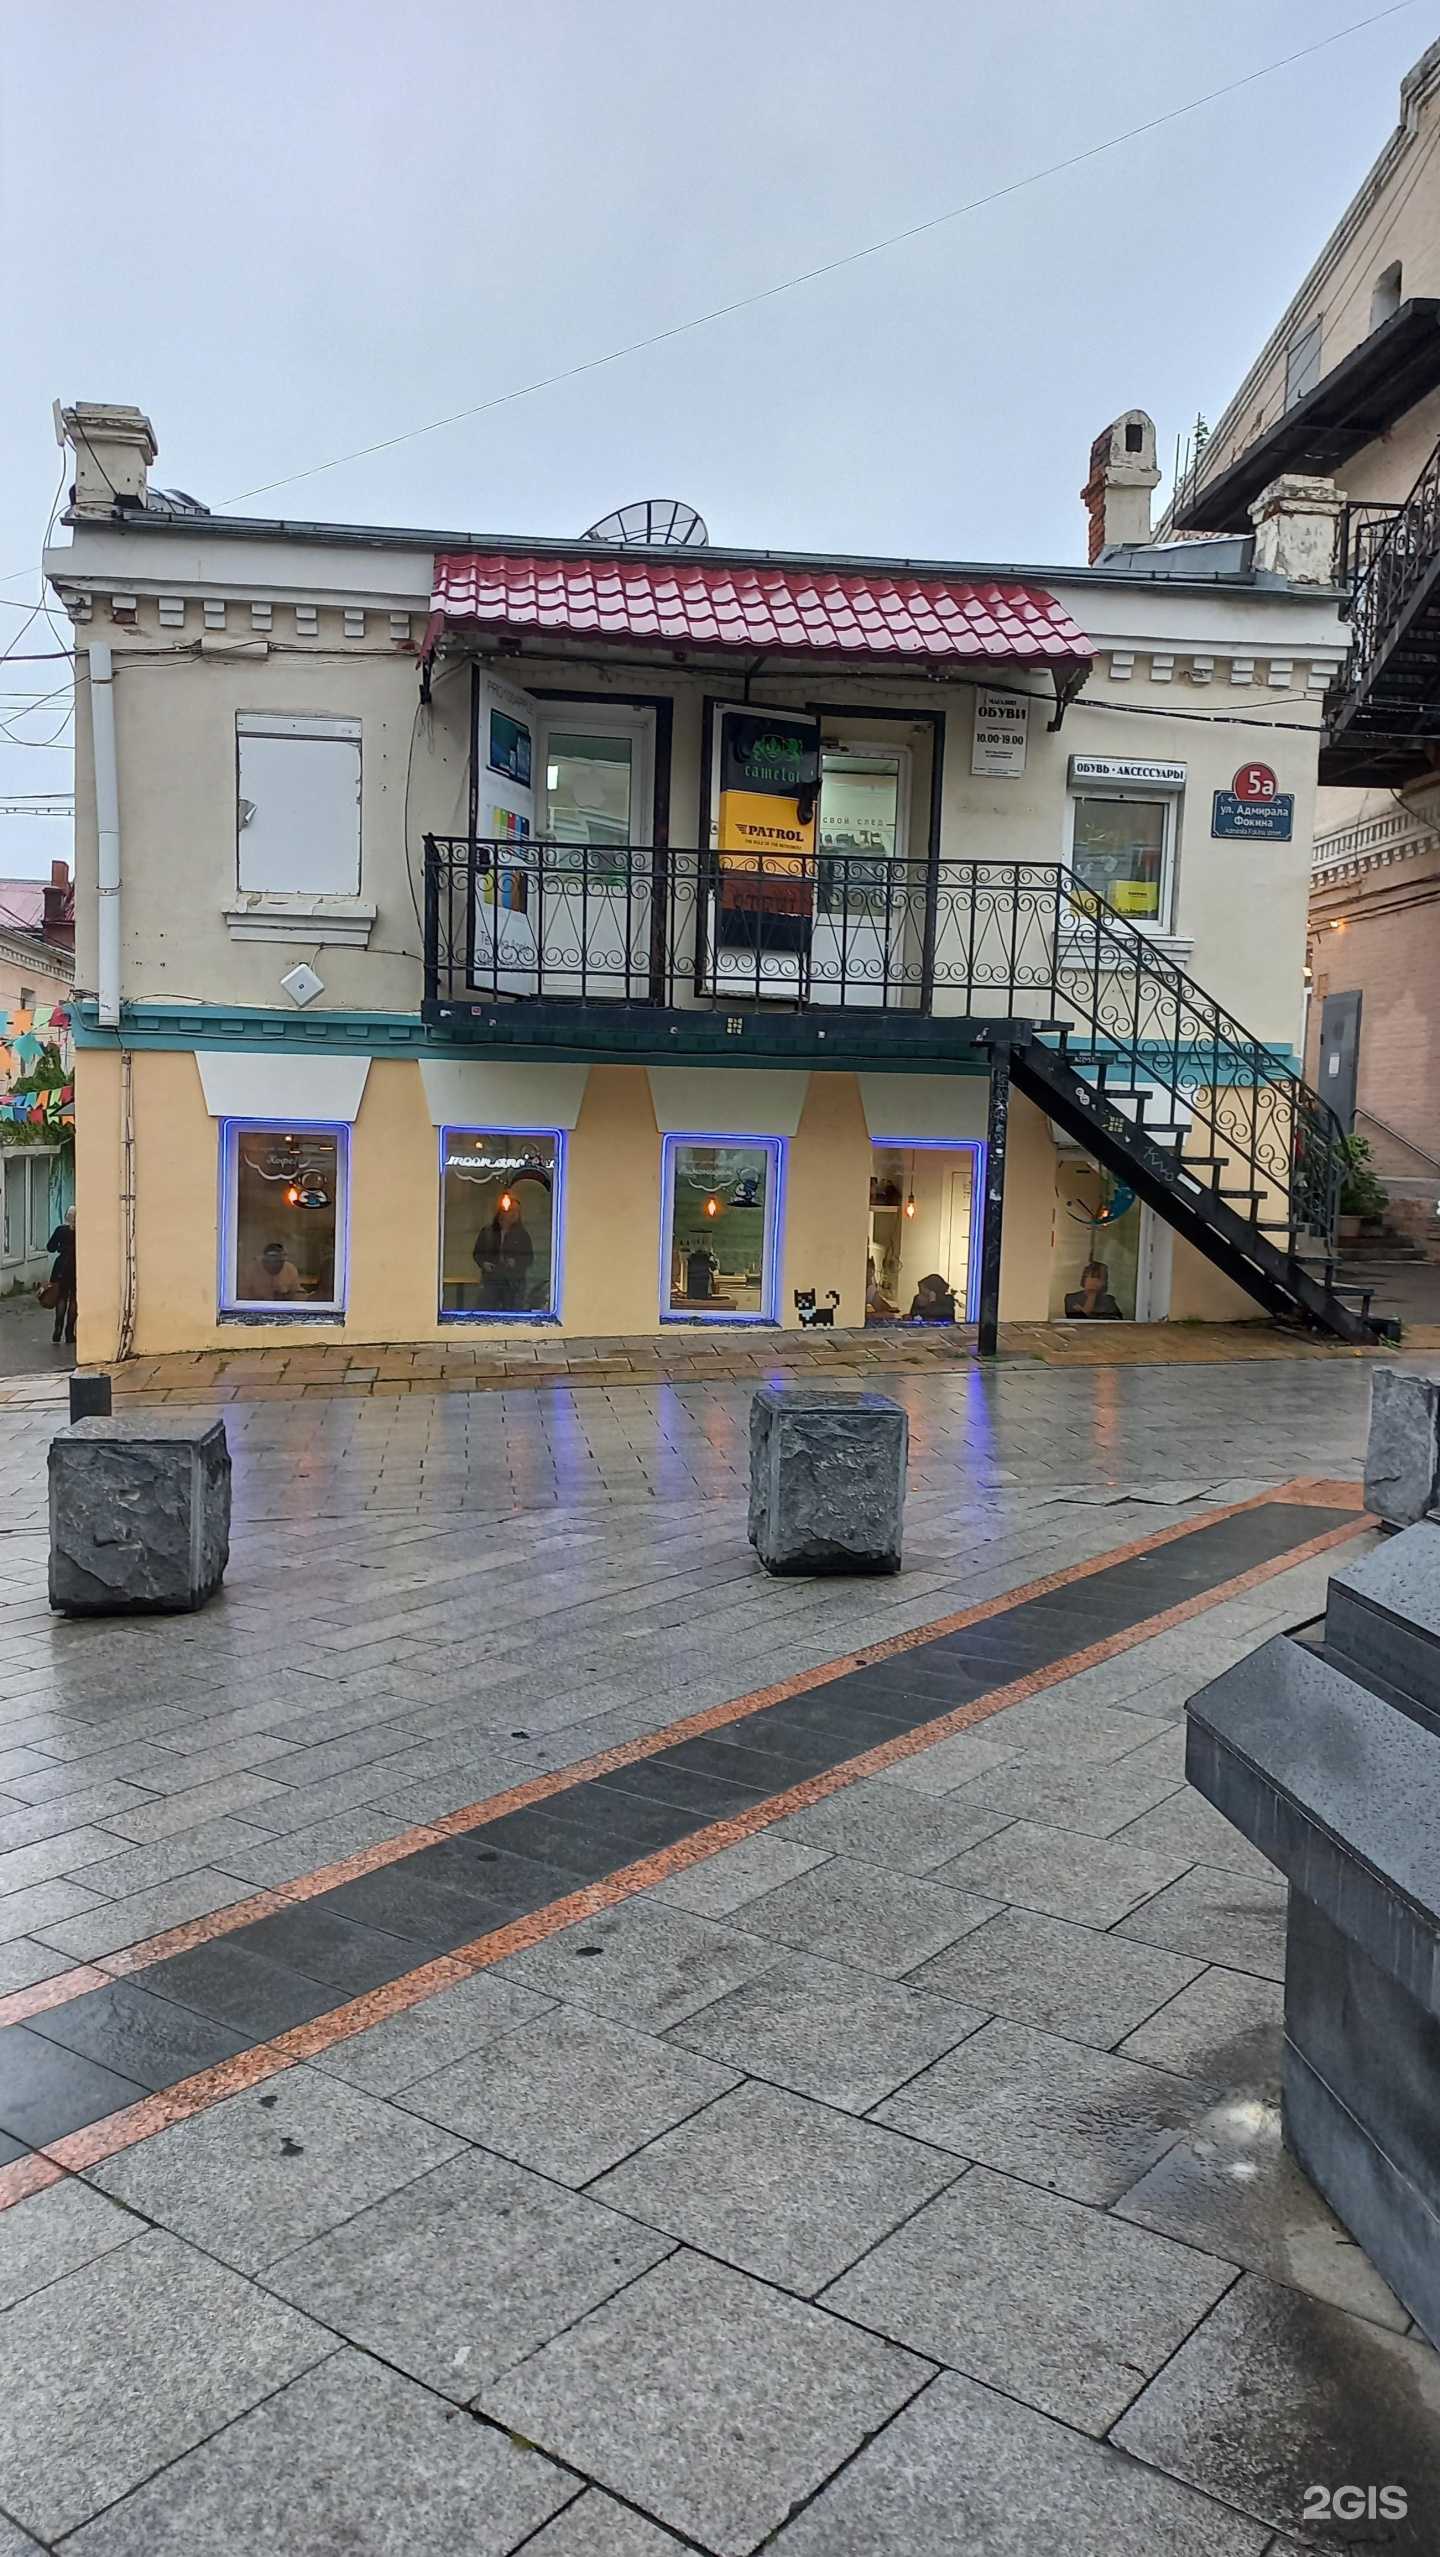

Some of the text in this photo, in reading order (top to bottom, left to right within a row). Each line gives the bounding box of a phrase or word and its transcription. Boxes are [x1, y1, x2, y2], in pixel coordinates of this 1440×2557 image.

[978, 706, 1026, 720] ОБУВИ
[976, 733, 1024, 745] 10.00-19.00
[1076, 763, 1184, 780] ОБУВЬ АКСЕССУАРЫ
[1248, 771, 1274, 795] 5а
[1220, 805, 1289, 817] ул. Адмирала
[1234, 816, 1273, 828] Фокина
[748, 825, 804, 842] PATROL
